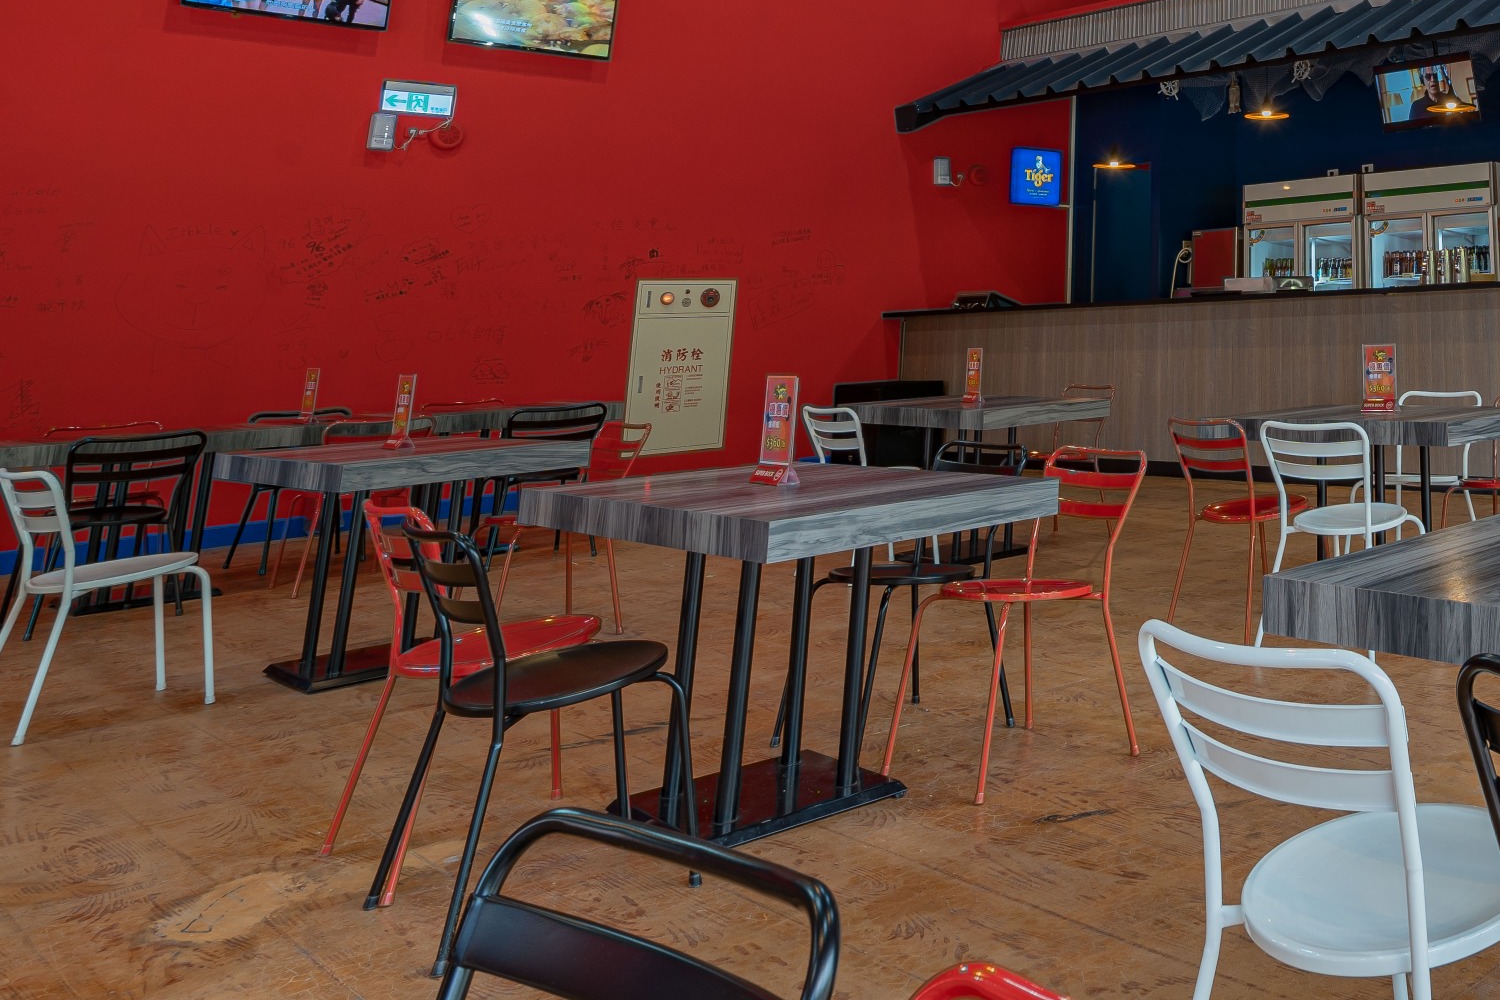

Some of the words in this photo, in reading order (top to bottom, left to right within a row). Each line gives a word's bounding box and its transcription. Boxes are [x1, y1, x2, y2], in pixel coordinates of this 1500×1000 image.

[1024, 168, 1054, 188] Tiger
[660, 347, 705, 362] 消防栓
[659, 364, 704, 375] HYDRANT
